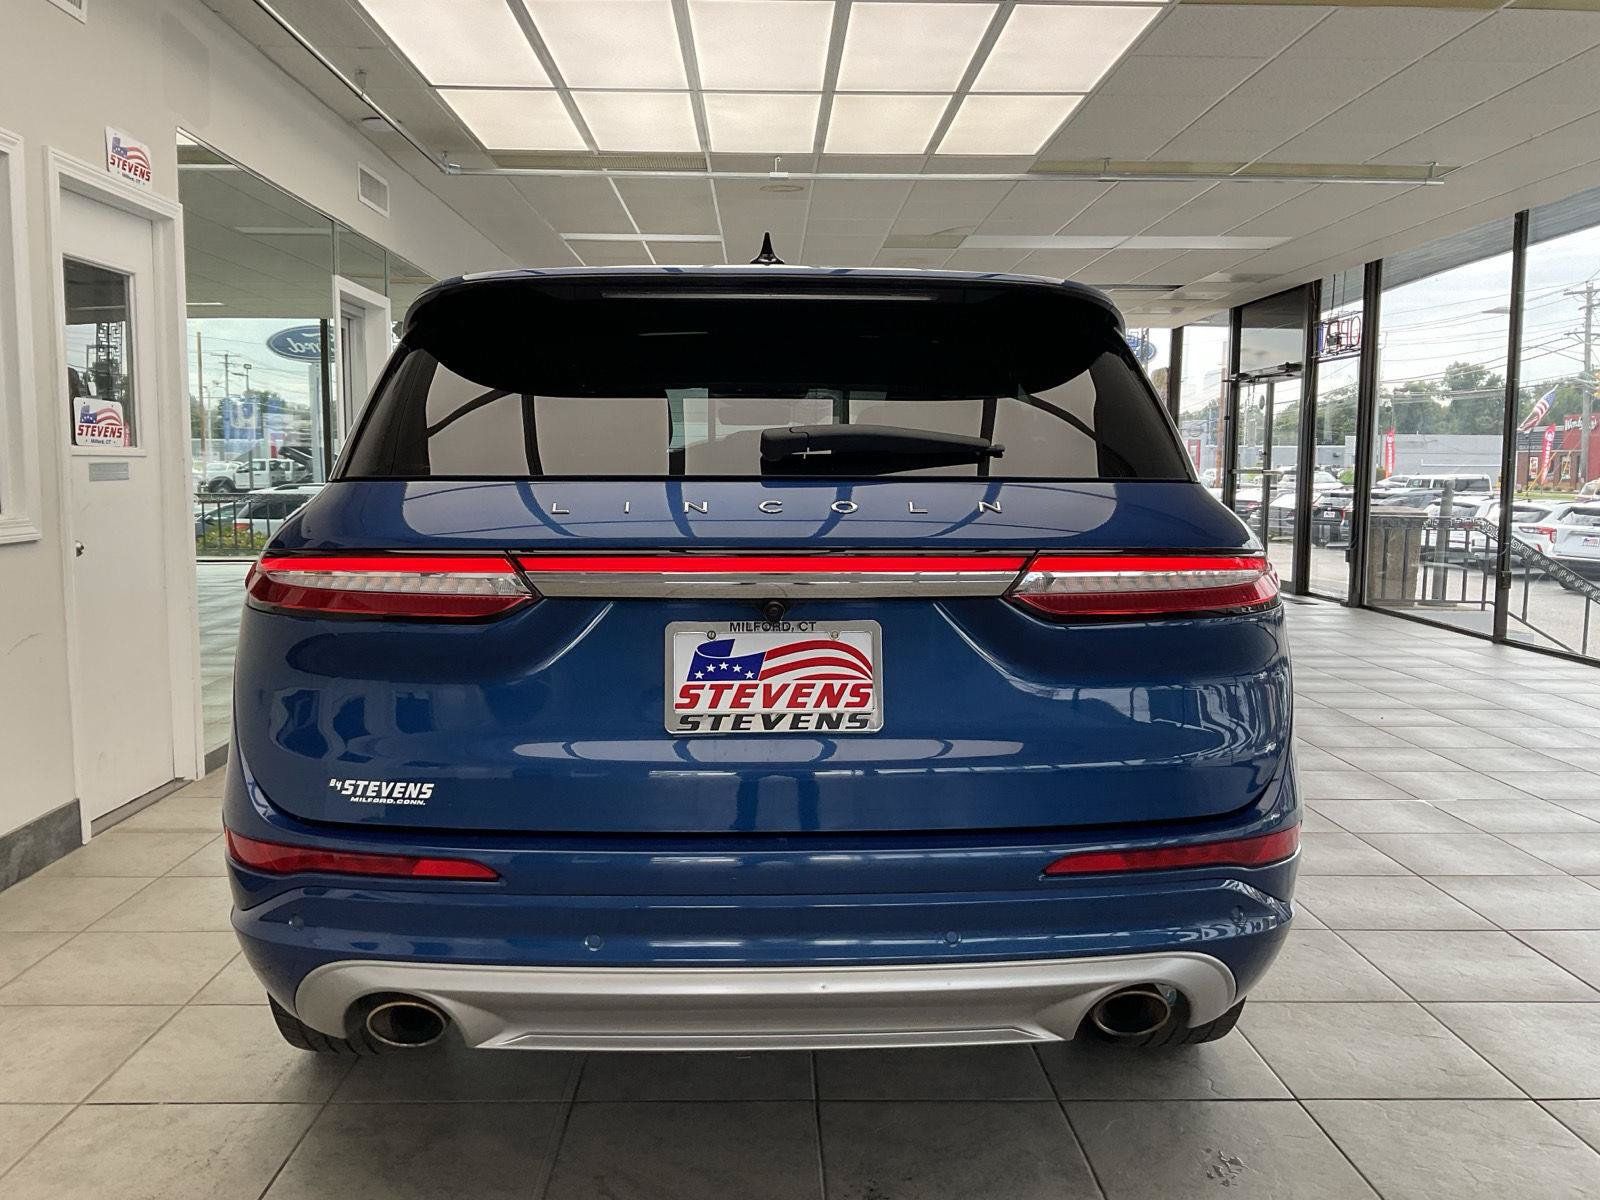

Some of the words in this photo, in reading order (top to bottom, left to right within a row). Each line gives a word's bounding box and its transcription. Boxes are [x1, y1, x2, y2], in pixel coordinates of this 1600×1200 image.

[109, 154, 151, 182] STEVENS
[77, 424, 123, 438] STEVENS
[550, 499, 1004, 515] LINCOLN
[799, 621, 816, 632] CT
[674, 682, 873, 710] STEVENS
[676, 712, 872, 731] STEVENS
[341, 780, 435, 799] STEVENS
